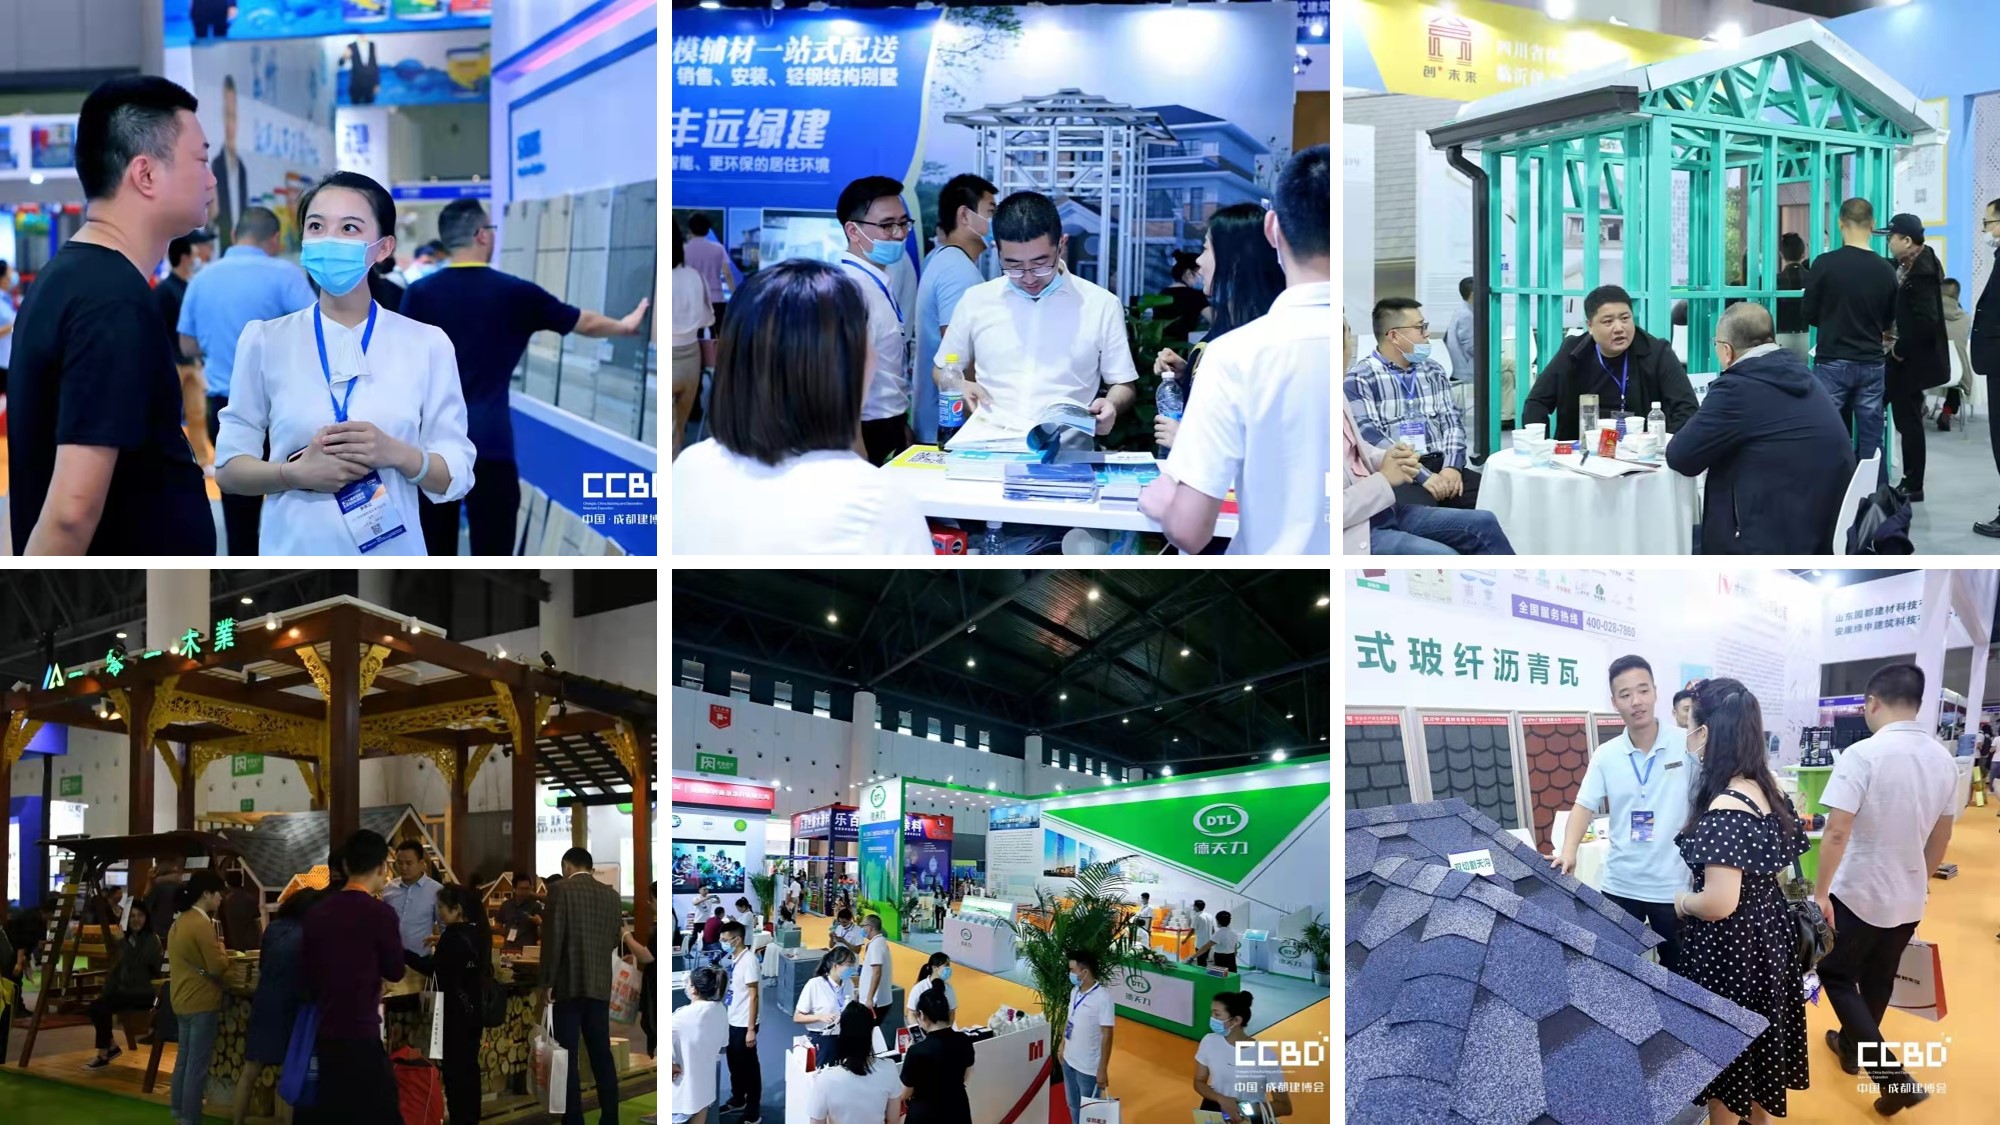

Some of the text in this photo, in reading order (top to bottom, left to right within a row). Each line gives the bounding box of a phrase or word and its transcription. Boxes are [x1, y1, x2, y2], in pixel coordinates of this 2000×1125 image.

[673, 36, 899, 65] 模辅材一站式配送
[676, 66, 899, 87] 销售、安装、轻钢结构别墅
[1518, 600, 1579, 625] 全国服务热线
[1354, 630, 1579, 687] 式玻纤沥青瓦
[1206, 814, 1236, 827] DTL
[1193, 841, 1248, 855] 德天力
[1131, 980, 1146, 989] DTL
